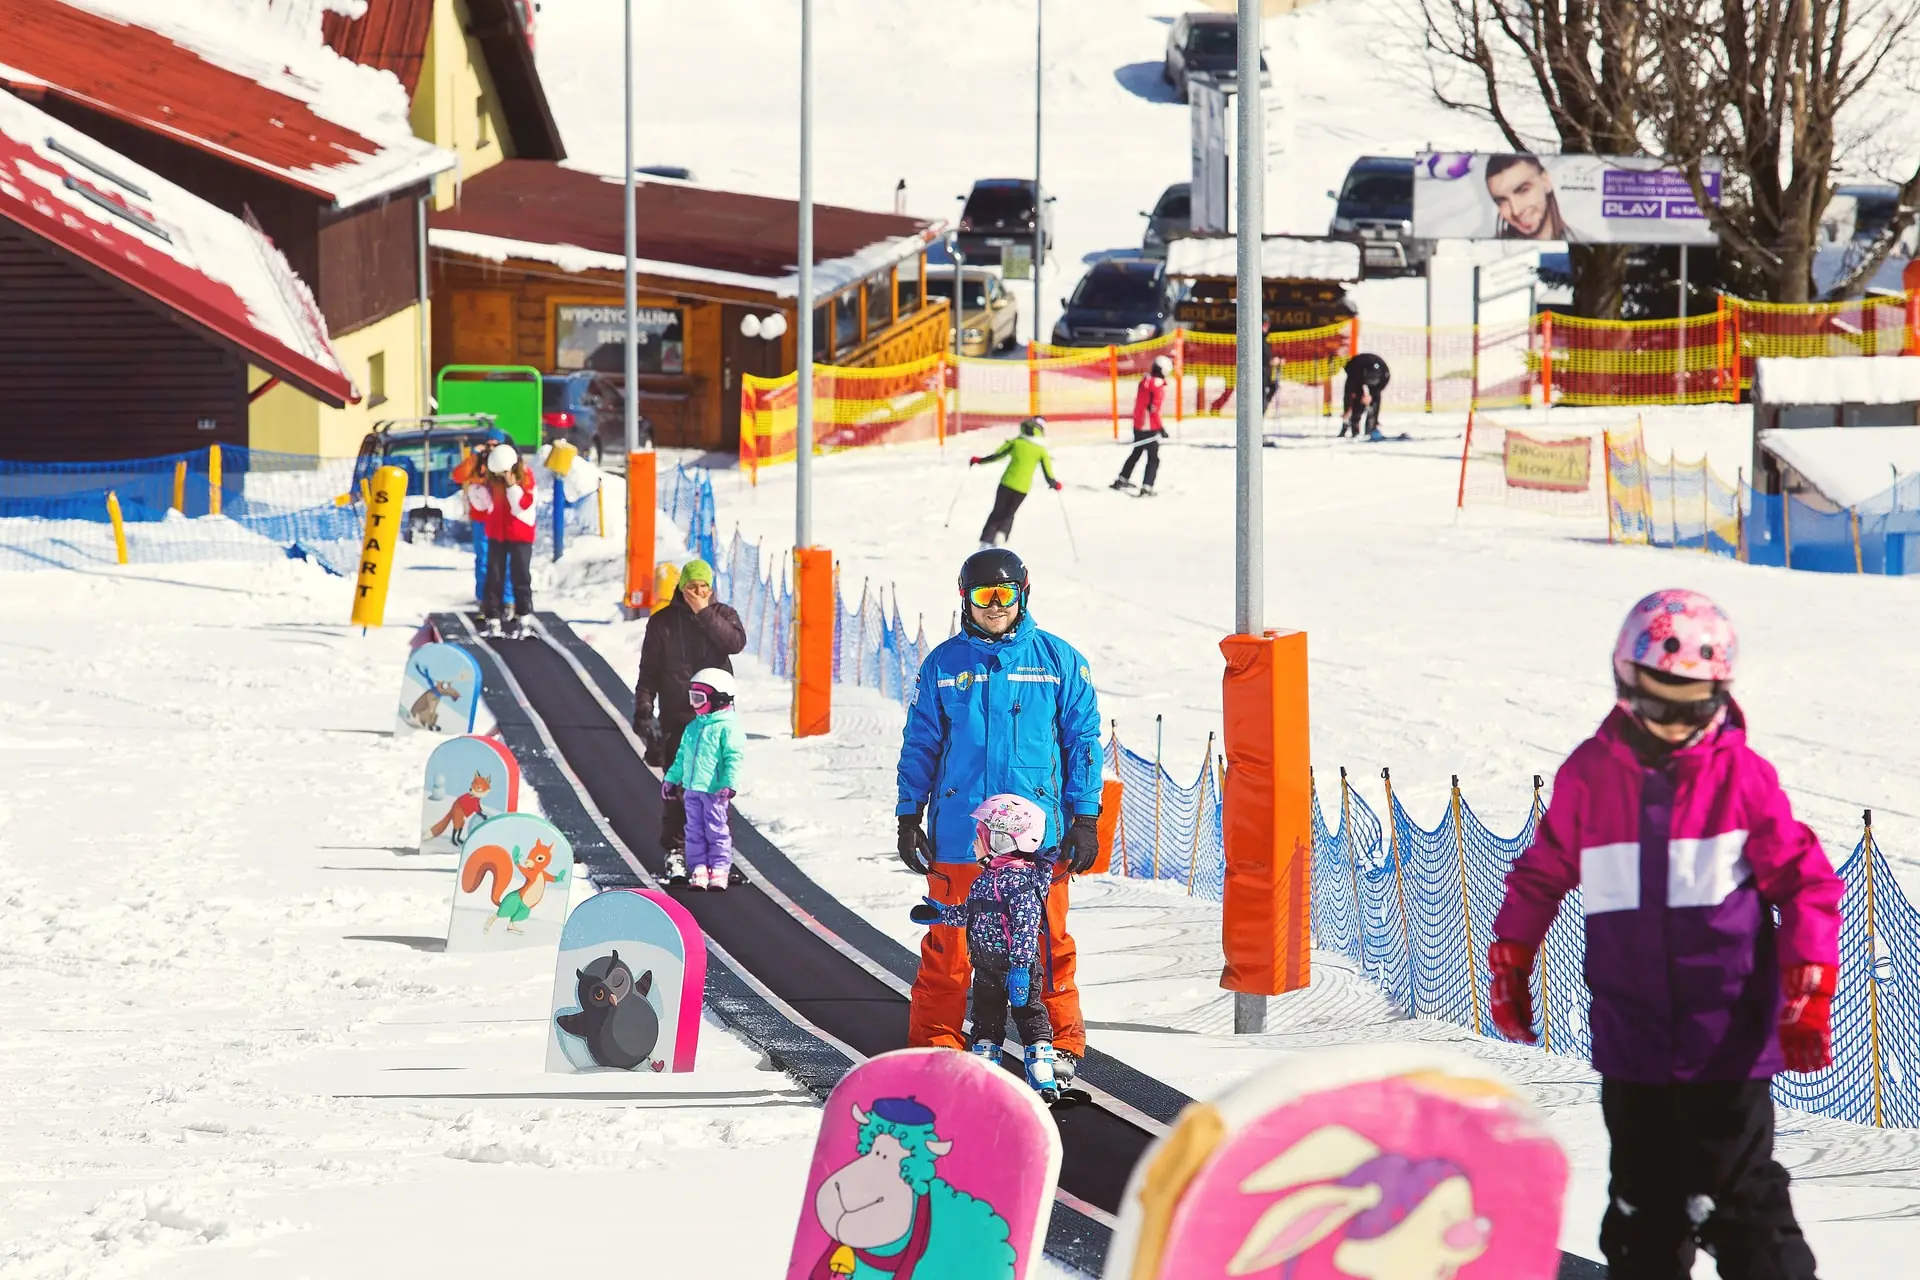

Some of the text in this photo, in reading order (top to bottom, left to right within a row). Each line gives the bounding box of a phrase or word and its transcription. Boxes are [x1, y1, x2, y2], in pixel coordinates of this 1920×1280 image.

[1604, 202, 1658, 215] PLAY
[560, 306, 677, 324] WYPOŻYCALNIA
[358, 490, 388, 597] START
